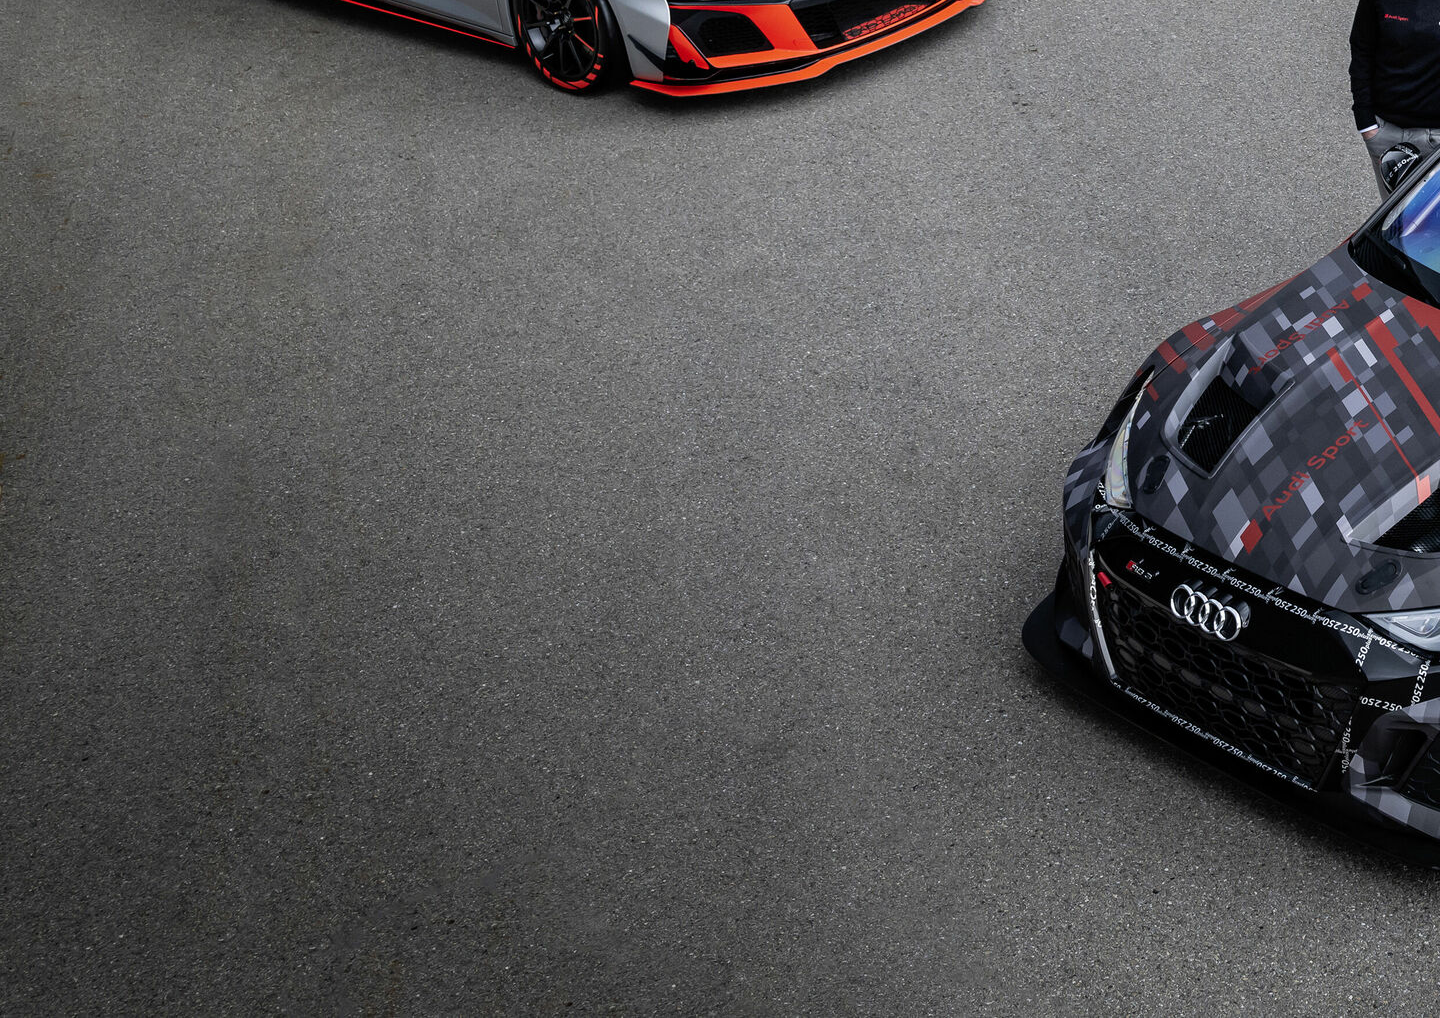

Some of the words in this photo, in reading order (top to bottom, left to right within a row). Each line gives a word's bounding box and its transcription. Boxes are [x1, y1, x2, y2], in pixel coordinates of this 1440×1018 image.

[1303, 298, 1350, 331] Audi
[1248, 332, 1306, 375] Sport
[1262, 471, 1311, 522] Audi
[1307, 419, 1370, 471] Sport
